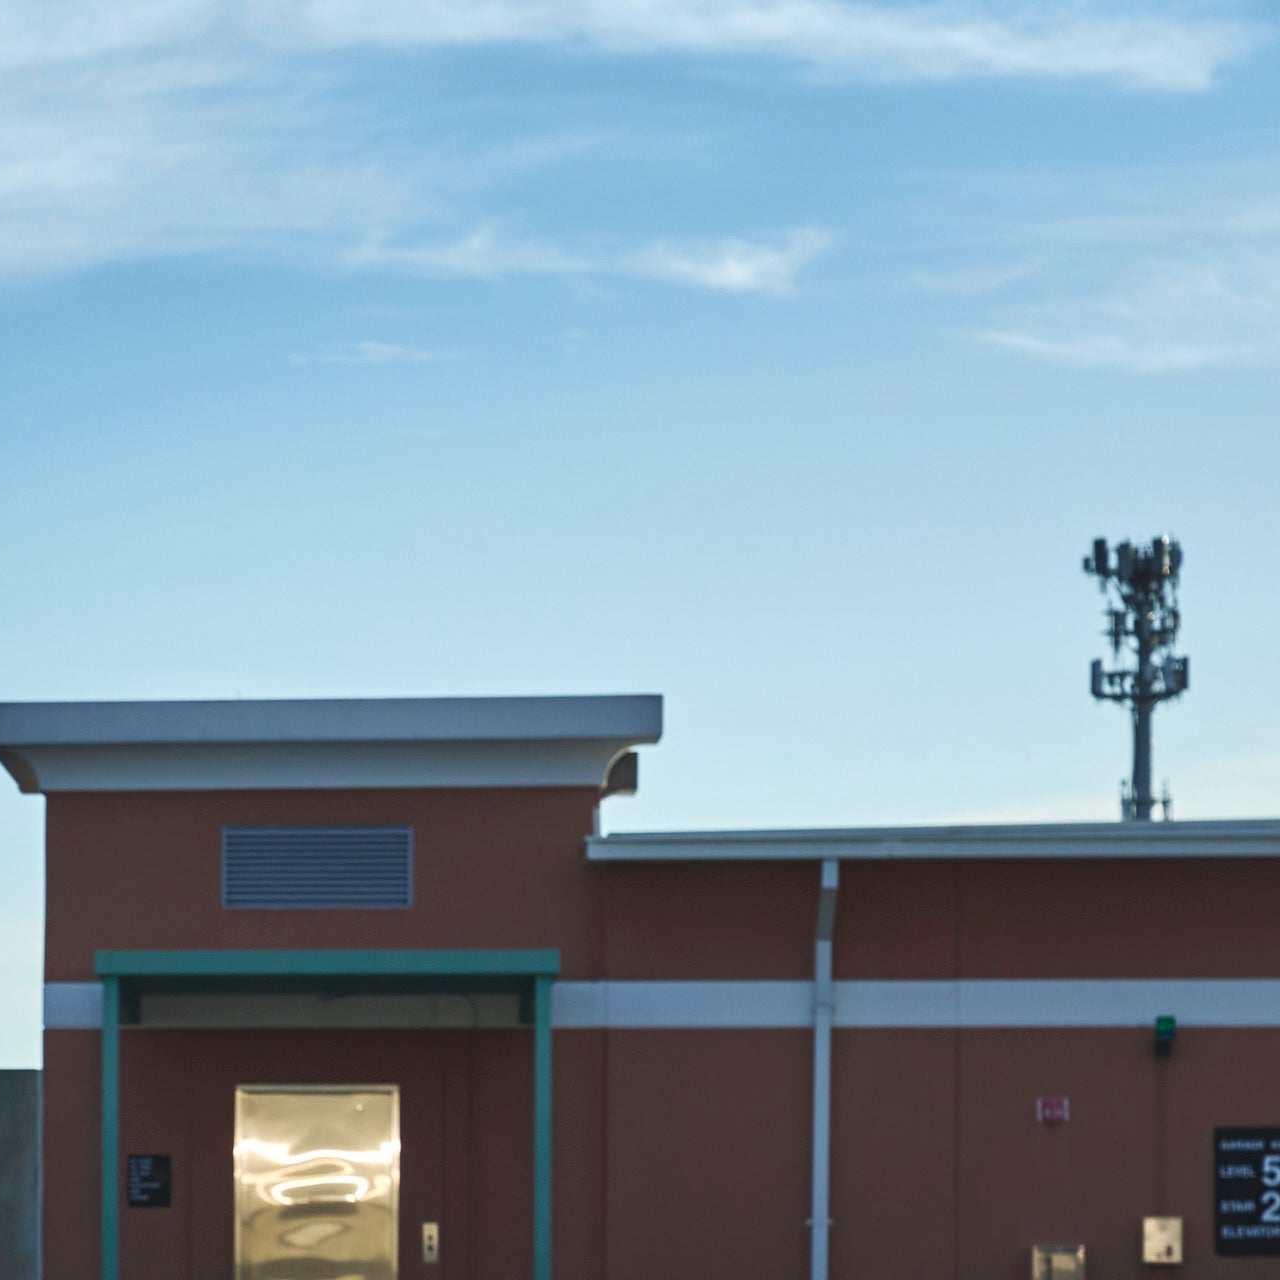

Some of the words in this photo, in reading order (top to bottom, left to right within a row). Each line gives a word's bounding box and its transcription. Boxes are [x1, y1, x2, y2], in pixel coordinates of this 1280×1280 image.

[1219, 1165, 1254, 1178] LEVEL
[1262, 1155, 1280, 1186] 5
[1261, 1191, 1280, 1222] 2
